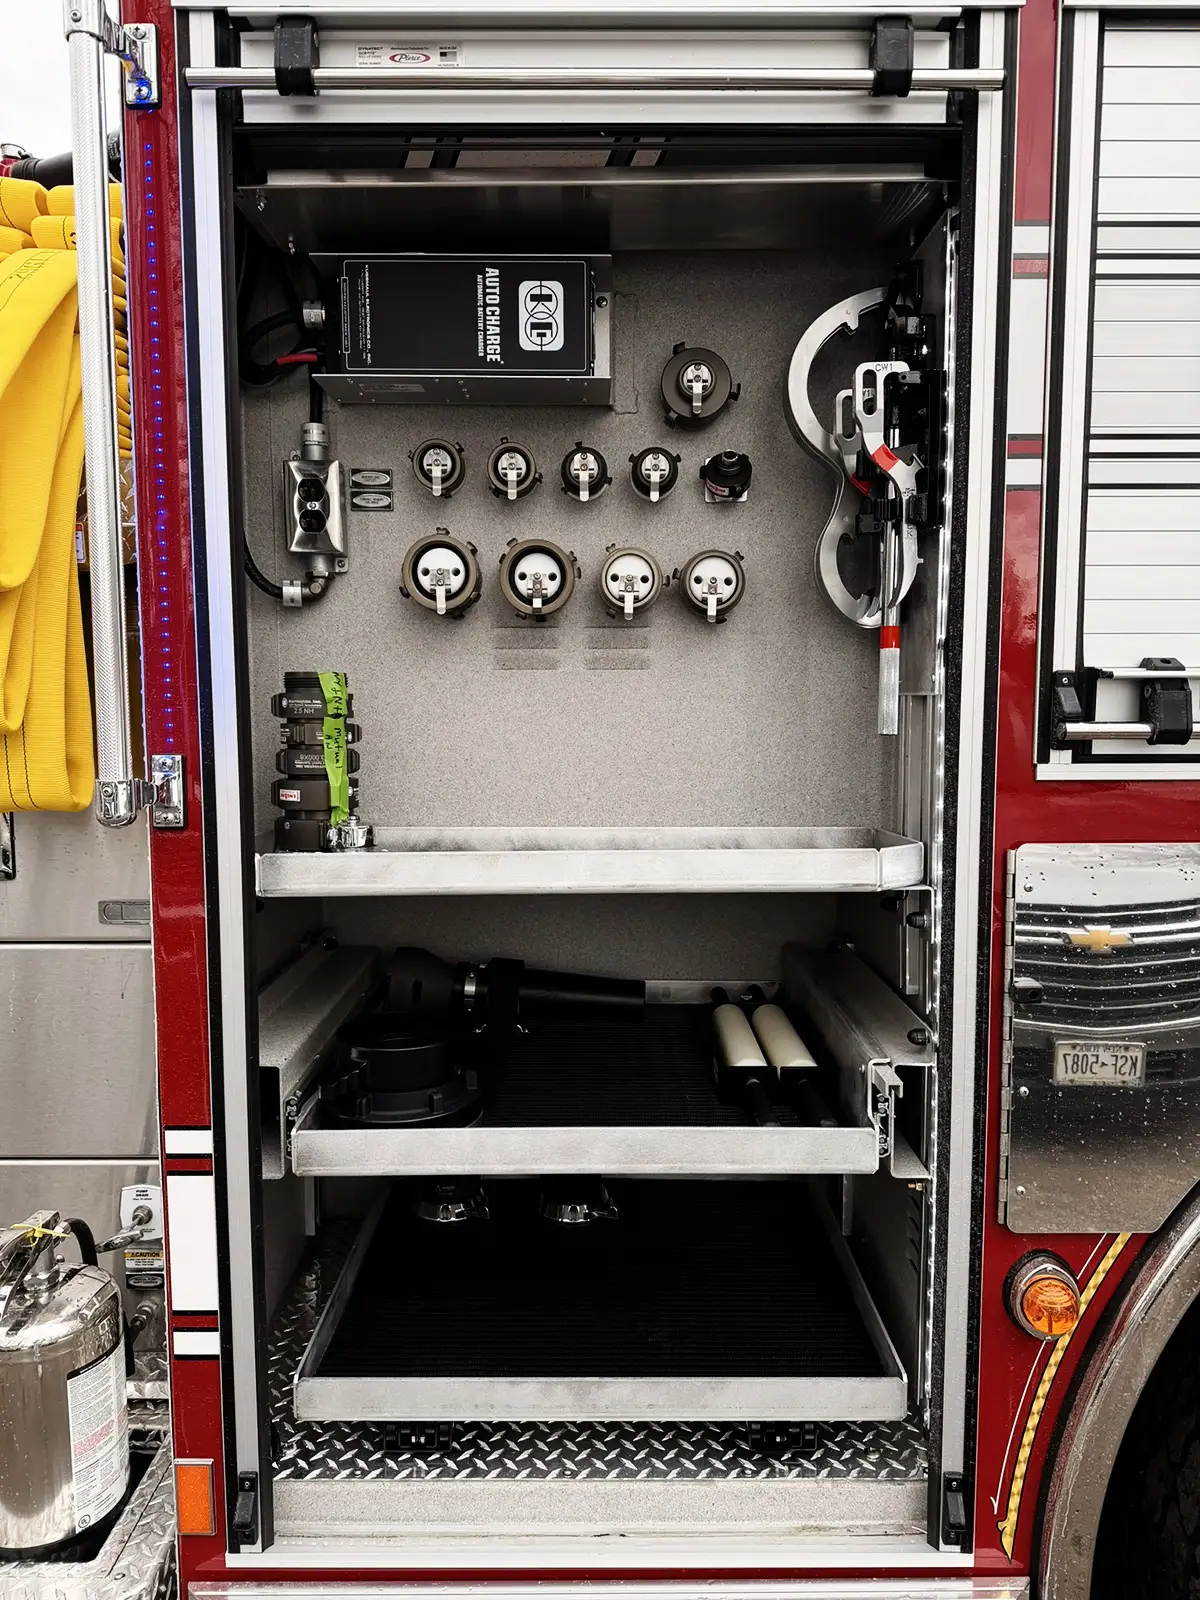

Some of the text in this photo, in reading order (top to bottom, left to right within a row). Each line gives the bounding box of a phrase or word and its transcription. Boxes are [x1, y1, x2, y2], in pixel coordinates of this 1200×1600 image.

[476, 274, 484, 306] AUTOMATIC
[485, 267, 501, 363] AUTO CHARGE
[477, 331, 485, 357] CHARGER
[875, 363, 893, 372] CW1
[334, 727, 343, 769] Mutual
